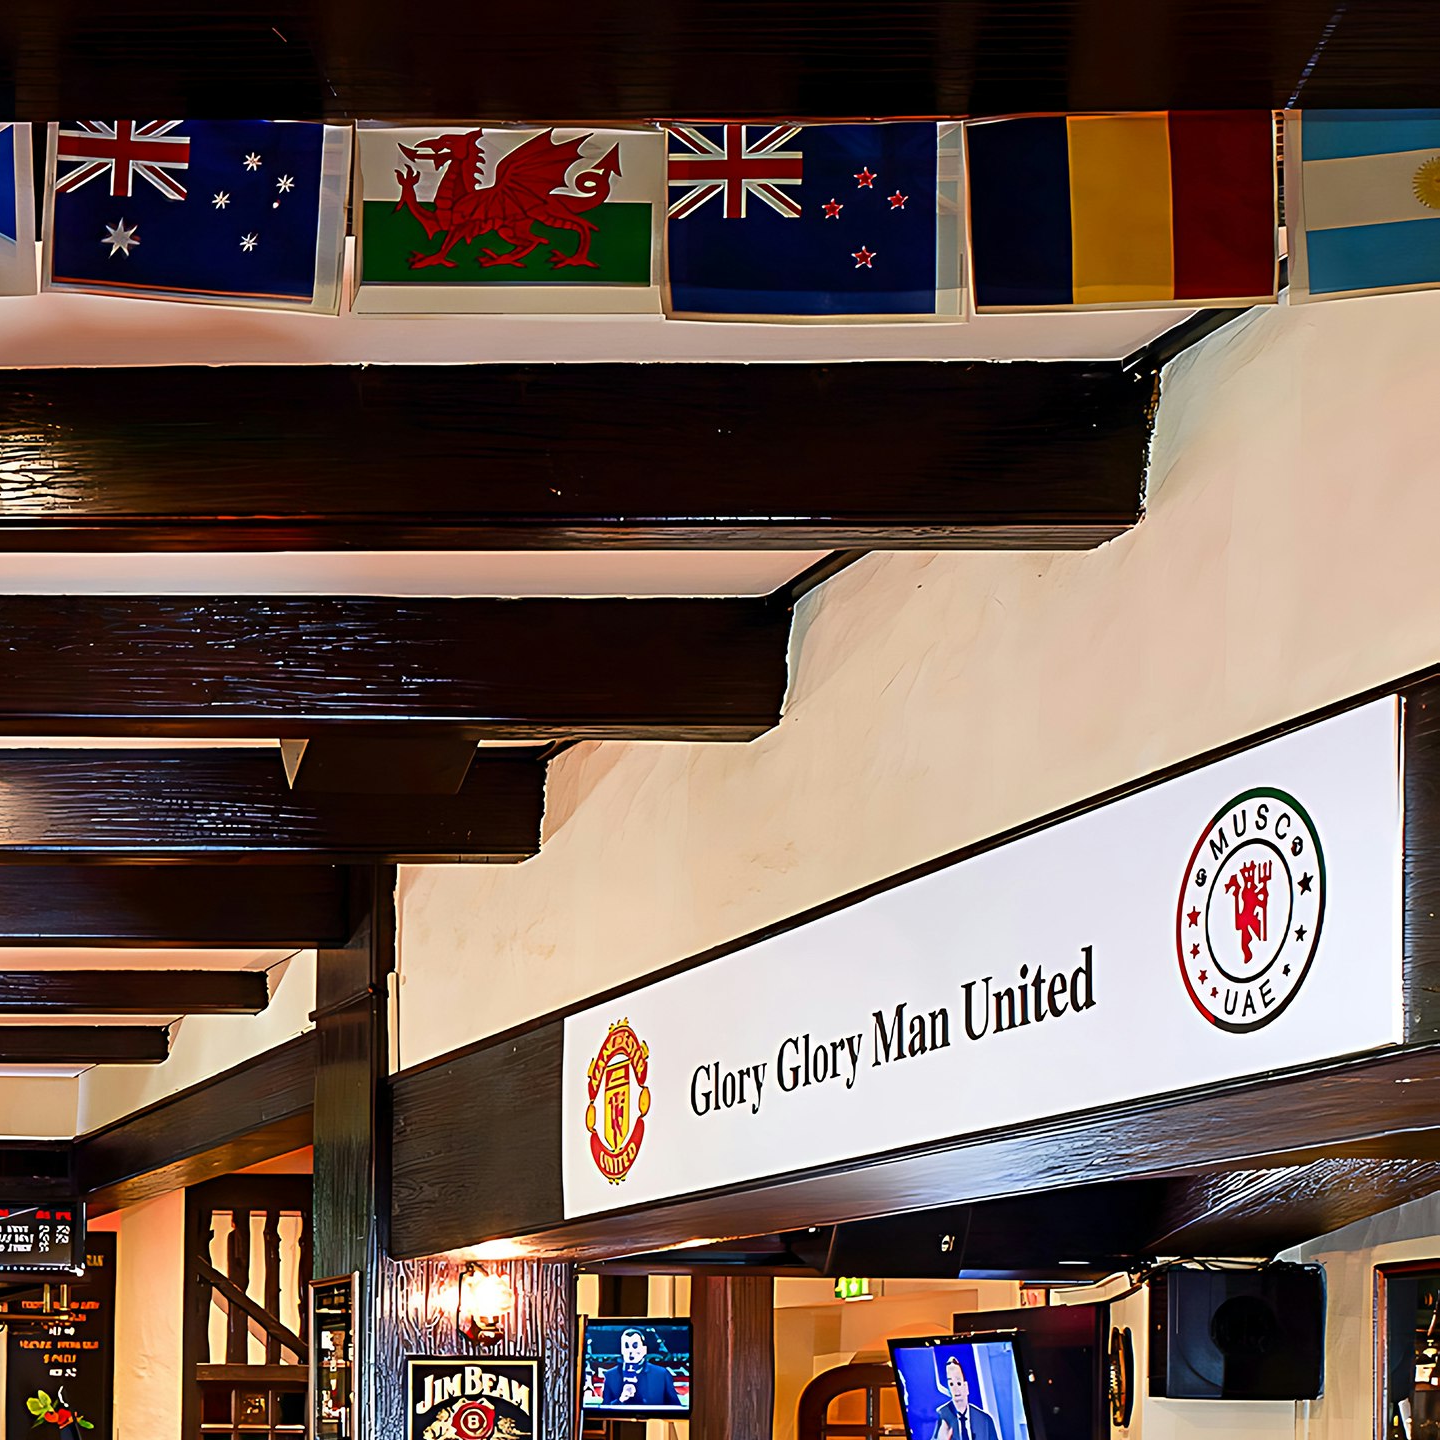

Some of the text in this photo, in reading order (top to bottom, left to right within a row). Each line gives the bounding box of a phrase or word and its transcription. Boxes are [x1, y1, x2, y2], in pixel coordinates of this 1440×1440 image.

[1208, 803, 1291, 861] MUSC
[1224, 978, 1276, 1018] UAE
[690, 944, 1097, 1116] Glory Glory Man United
[415, 1365, 531, 1417] JIM BEAM
